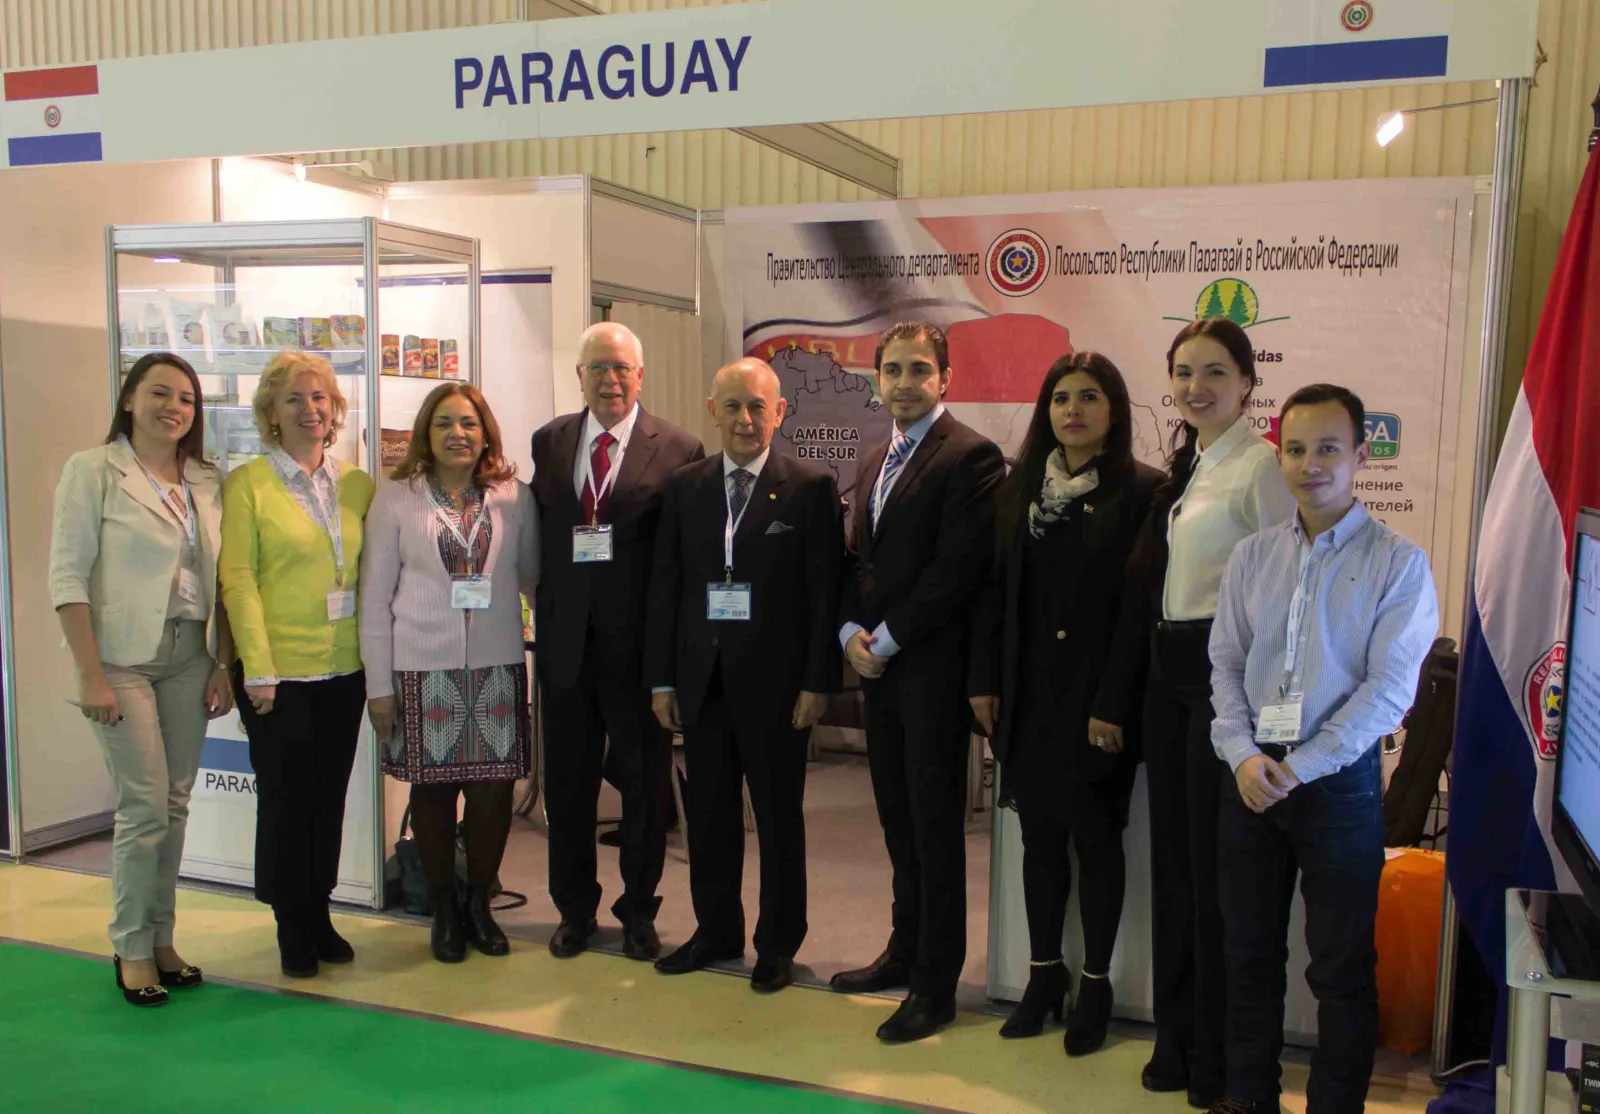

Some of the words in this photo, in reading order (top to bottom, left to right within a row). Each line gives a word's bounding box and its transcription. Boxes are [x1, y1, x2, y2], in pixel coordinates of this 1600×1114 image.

[454, 36, 752, 109] PARAGUAY
[1055, 244, 1117, 276] Посольство
[1119, 241, 1186, 281] Республики
[1188, 238, 1243, 274] Парагвай
[1246, 247, 1253, 272] в
[1255, 235, 1325, 272] Российской
[1327, 236, 1399, 277] Федерации
[767, 252, 836, 288] Правительство
[838, 251, 905, 284] Центрального
[907, 251, 979, 284] департамента
[1252, 350, 1283, 362] idas
[795, 424, 859, 440] AMÉRICA
[1363, 420, 1391, 441] SA
[797, 446, 824, 459] DEL
[828, 446, 856, 459] SUR
[1373, 463, 1398, 471] origen
[1353, 480, 1404, 491] нение
